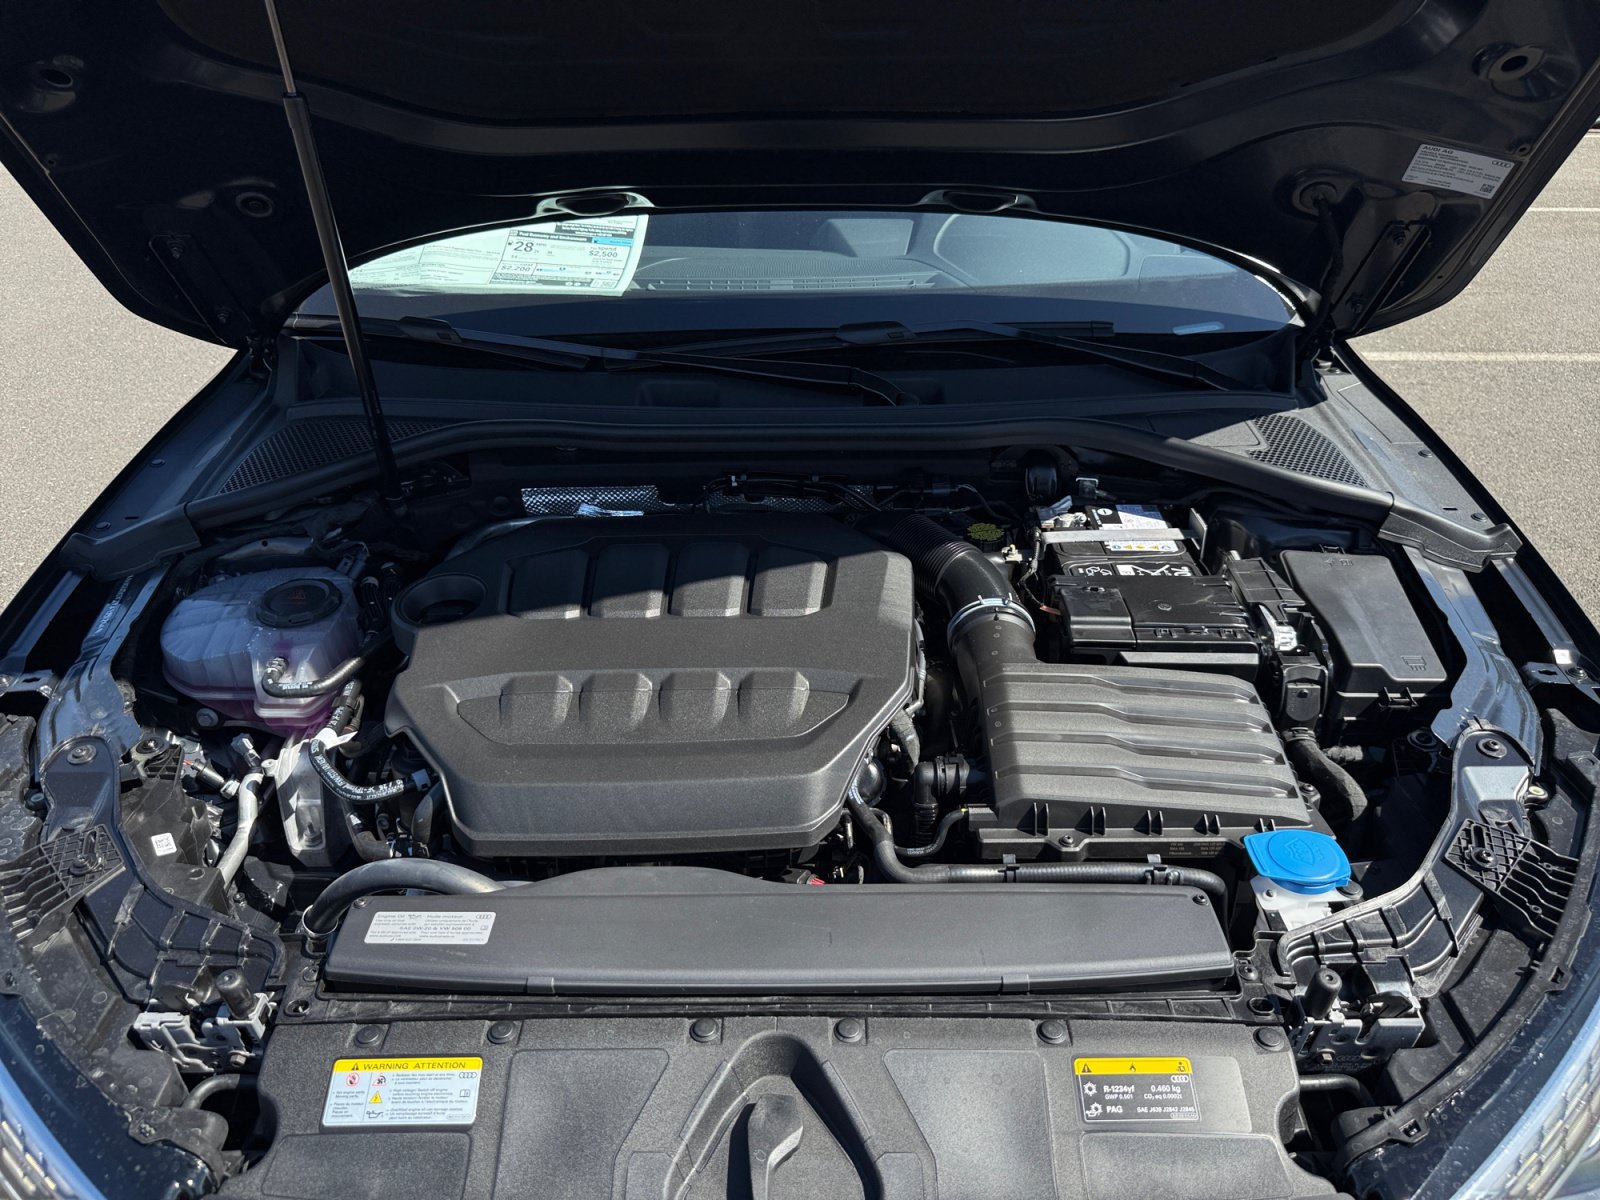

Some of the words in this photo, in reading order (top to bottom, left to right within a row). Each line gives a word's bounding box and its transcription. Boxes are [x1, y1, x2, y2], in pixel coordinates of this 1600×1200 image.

[513, 241, 534, 252] 28
[589, 250, 618, 258] $2,500
[501, 264, 531, 272] $2,200
[364, 1062, 409, 1070] WARNING
[413, 1061, 466, 1069] ATTENTION
[1103, 1085, 1135, 1093] R-1234yf
[1150, 1084, 1171, 1092] 0.460
[1171, 1084, 1181, 1093] kg
[1106, 1105, 1123, 1113] PAG
